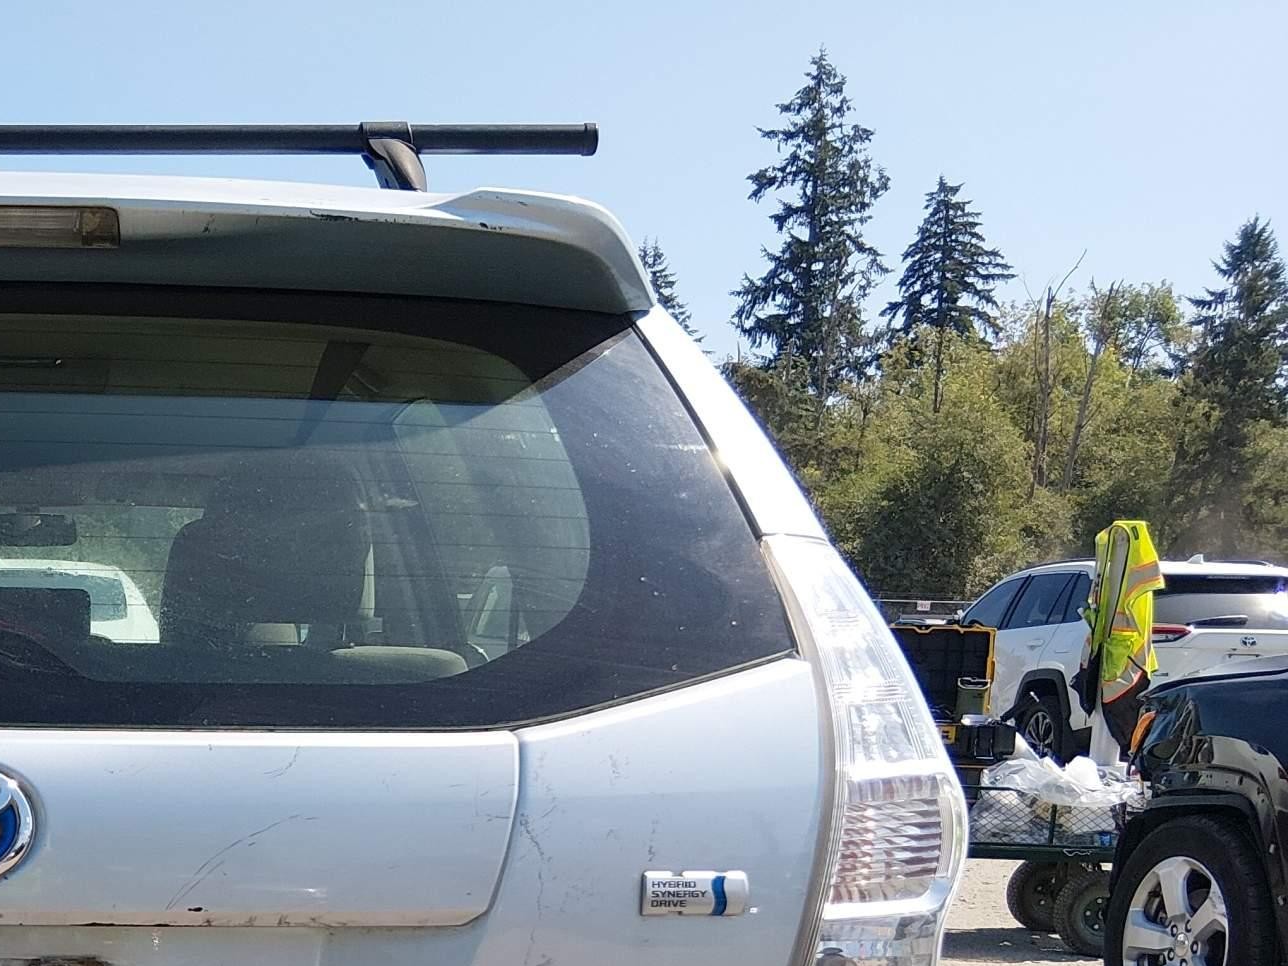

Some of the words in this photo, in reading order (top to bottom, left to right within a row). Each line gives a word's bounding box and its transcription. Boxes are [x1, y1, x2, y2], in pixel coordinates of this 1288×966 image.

[651, 880, 696, 889] HYBRID
[650, 890, 708, 898] SYNERGY
[650, 899, 687, 908] DRIVE
